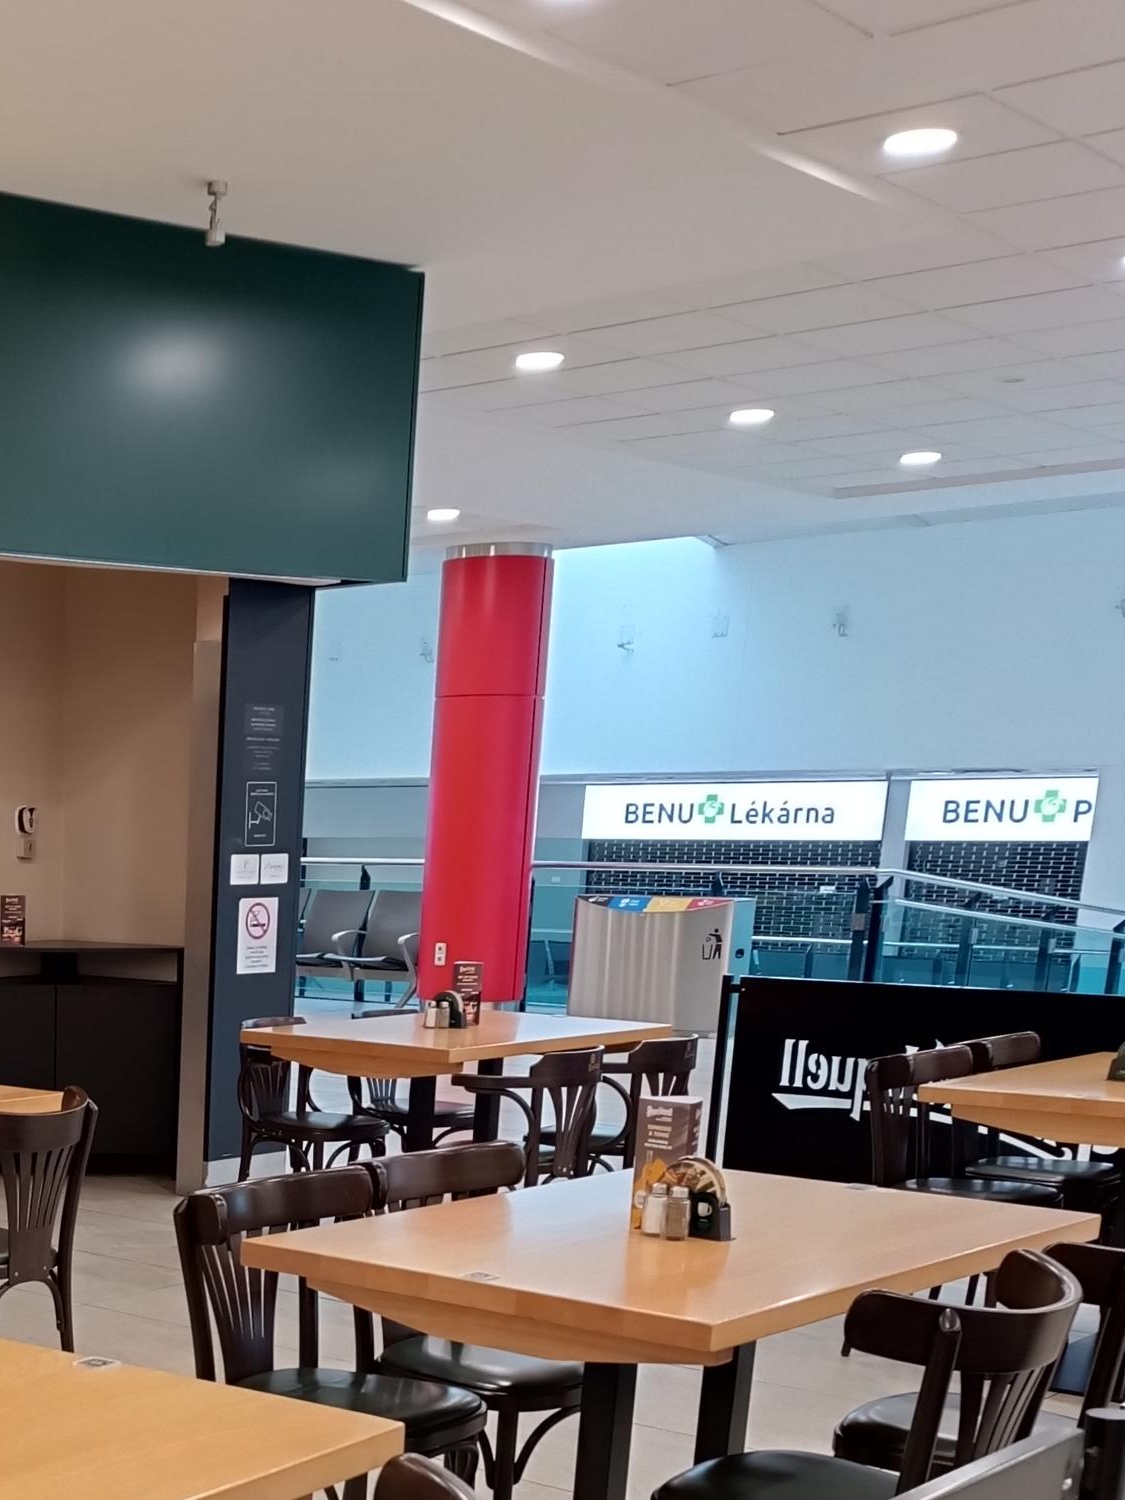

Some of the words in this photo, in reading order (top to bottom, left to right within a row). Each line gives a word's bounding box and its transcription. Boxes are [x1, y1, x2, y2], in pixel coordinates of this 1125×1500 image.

[624, 802, 695, 825] BENU
[730, 801, 836, 825] Lékárna
[942, 799, 1030, 824] BENU
